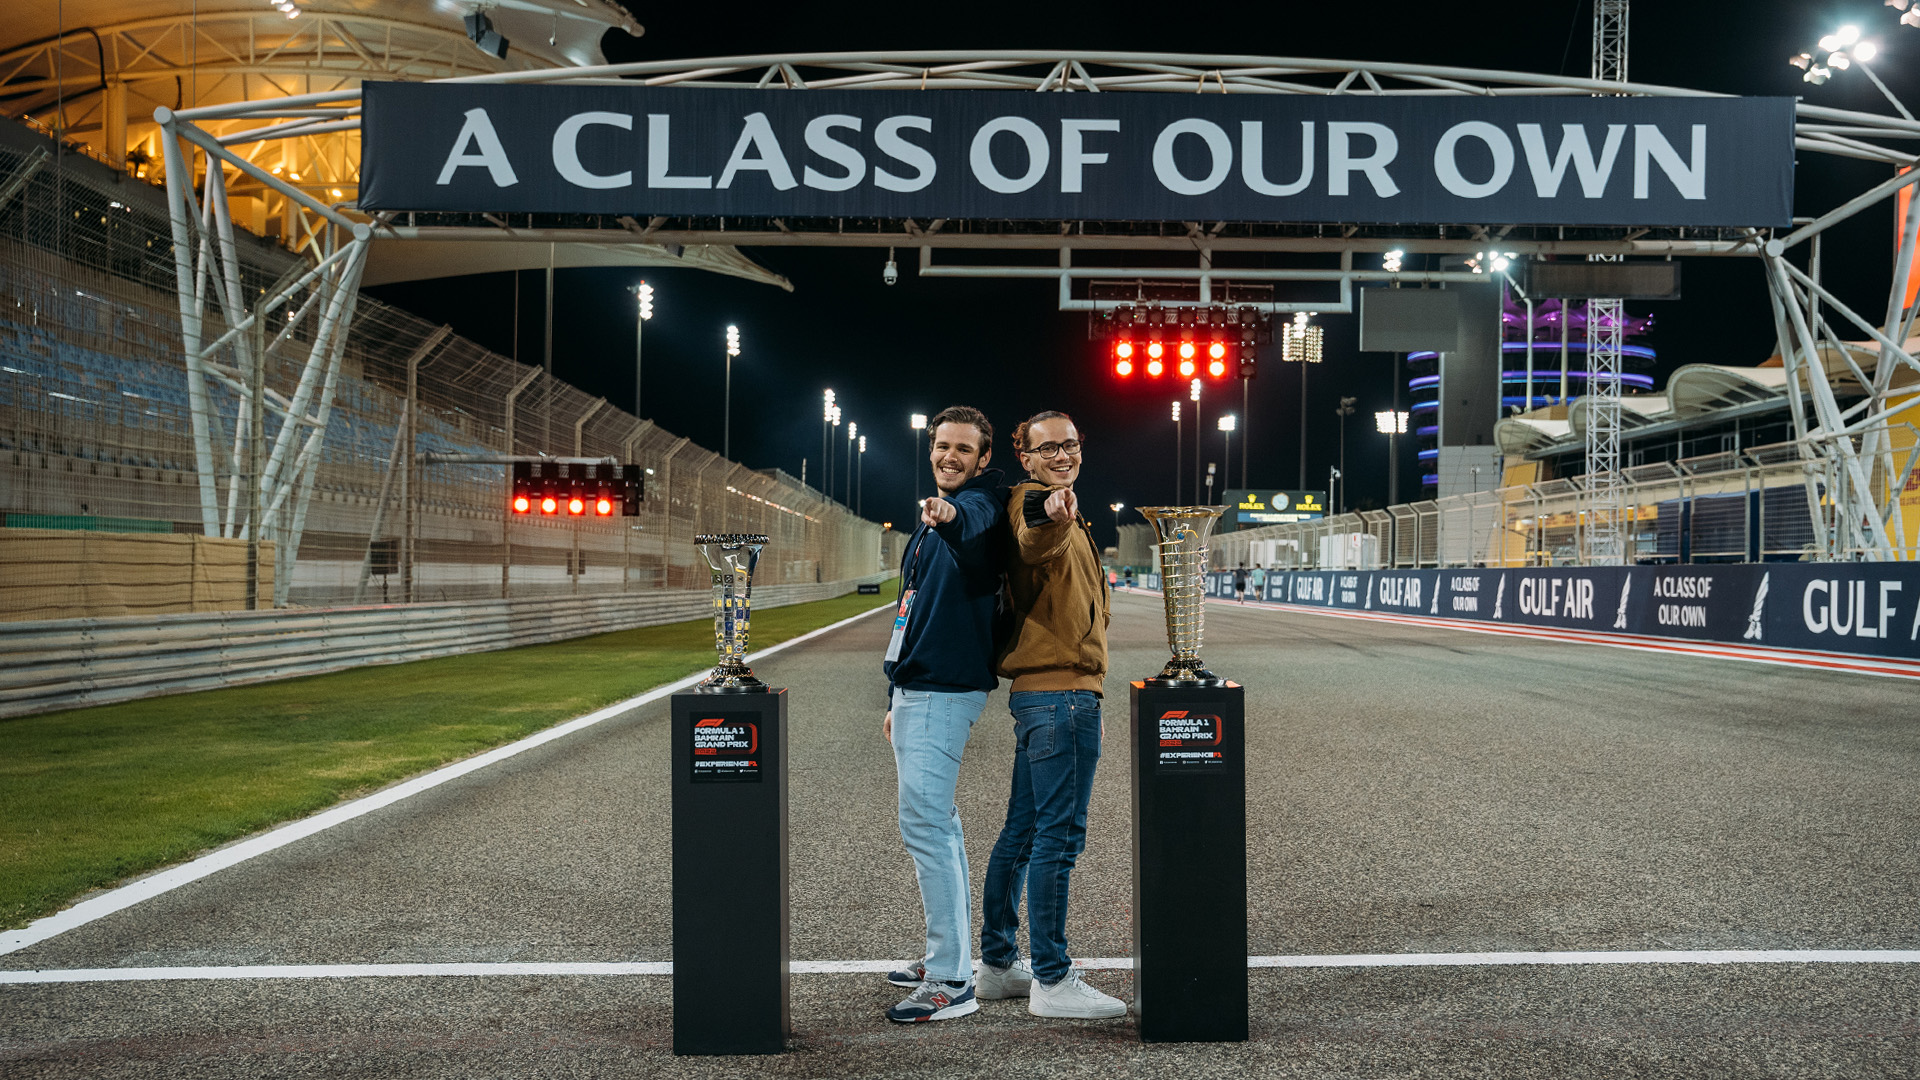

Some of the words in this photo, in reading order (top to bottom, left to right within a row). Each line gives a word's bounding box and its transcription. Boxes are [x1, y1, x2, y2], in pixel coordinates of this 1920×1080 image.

[437, 109, 518, 186] A
[553, 112, 936, 192] CLASS
[970, 117, 1119, 193] OF
[1153, 119, 1400, 198] OUR
[1434, 121, 1706, 199] OWN
[1239, 502, 1265, 510] ROLEX
[1296, 503, 1322, 511] ROLEX
[1380, 577, 1404, 606] GULF
[1404, 577, 1421, 608] AIR
[1519, 578, 1562, 616] GULF
[1563, 577, 1594, 620] AIR
[1654, 577, 1662, 596] A
[1663, 577, 1696, 598] CLASS
[1697, 577, 1712, 598] OF
[1658, 604, 1680, 626] OUR
[1681, 605, 1706, 627] OWN
[1803, 579, 1902, 638] GULF
